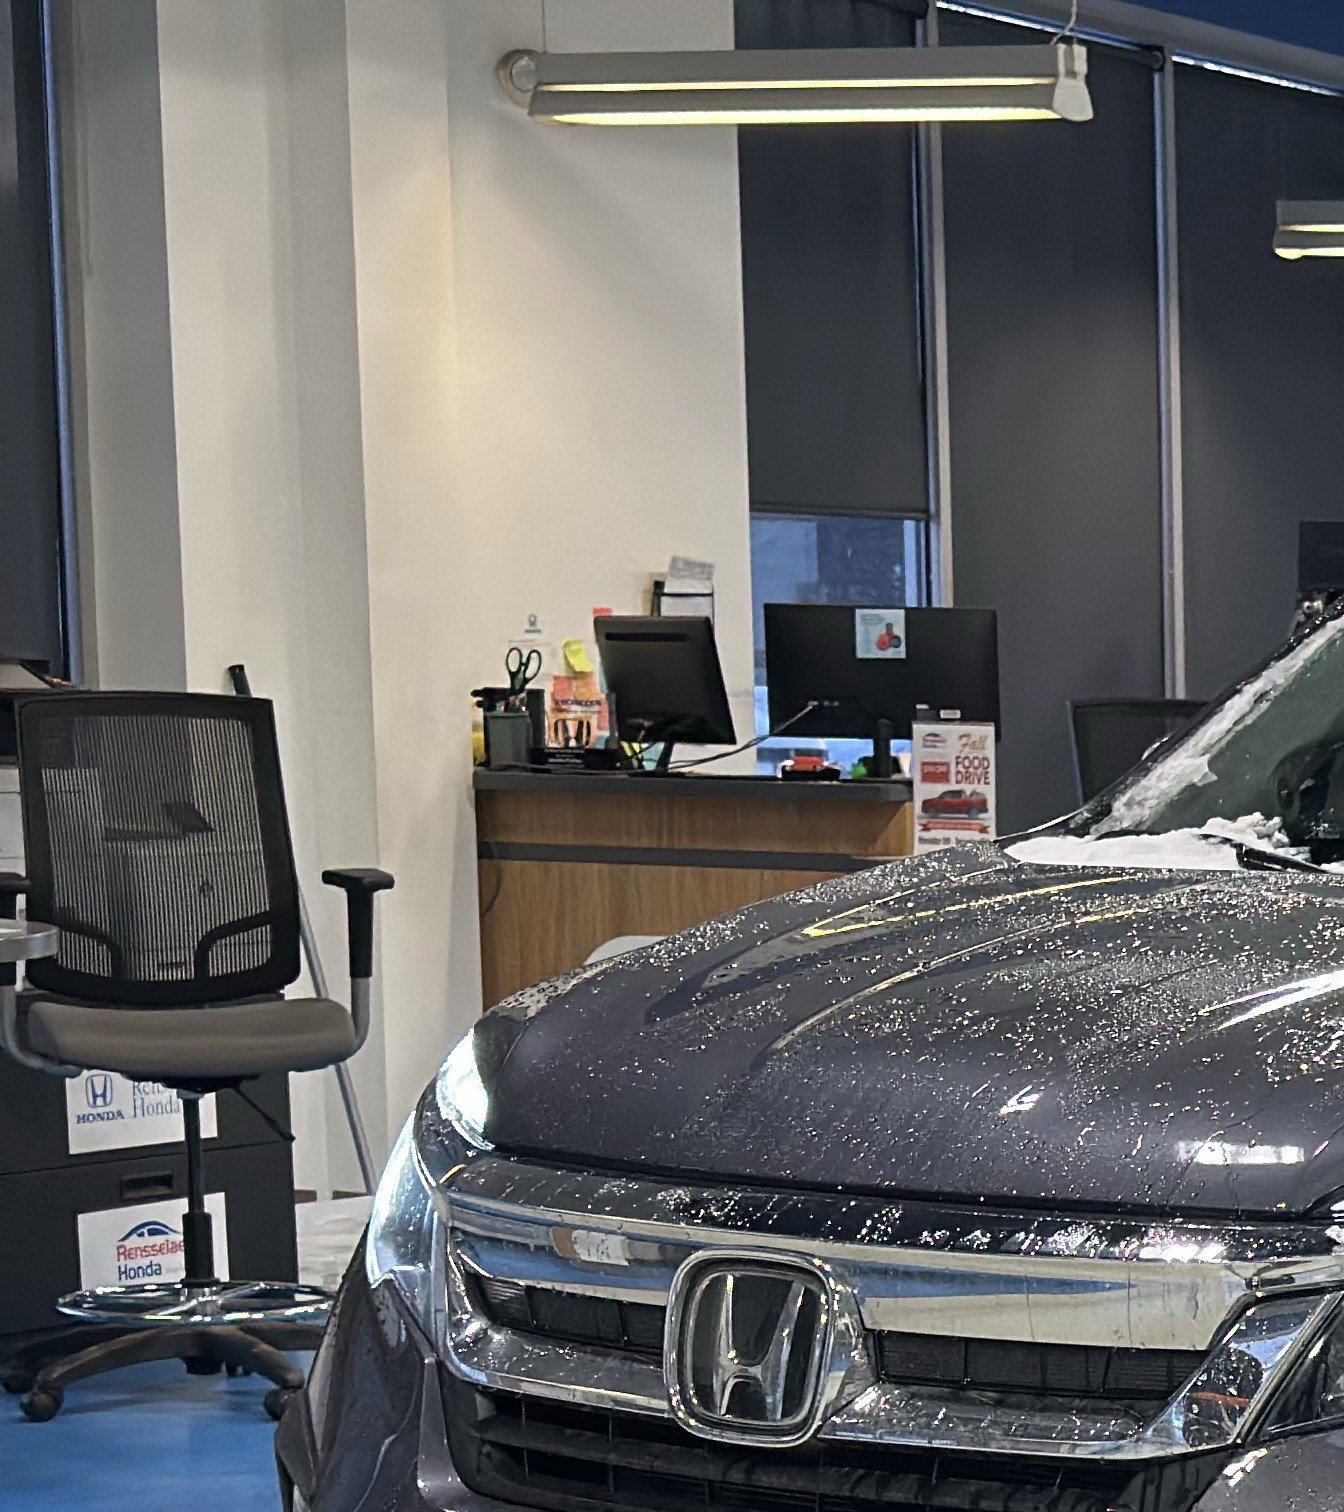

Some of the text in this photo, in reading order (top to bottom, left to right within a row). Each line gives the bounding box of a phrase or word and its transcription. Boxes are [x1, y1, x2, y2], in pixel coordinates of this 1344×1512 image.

[954, 755, 991, 771] FOOD
[954, 770, 991, 786] DRIVE
[133, 1095, 181, 1118] Honda
[76, 1109, 125, 1125] HONDA
[116, 1238, 185, 1262] Rensselae
[117, 1260, 163, 1282] Honda
